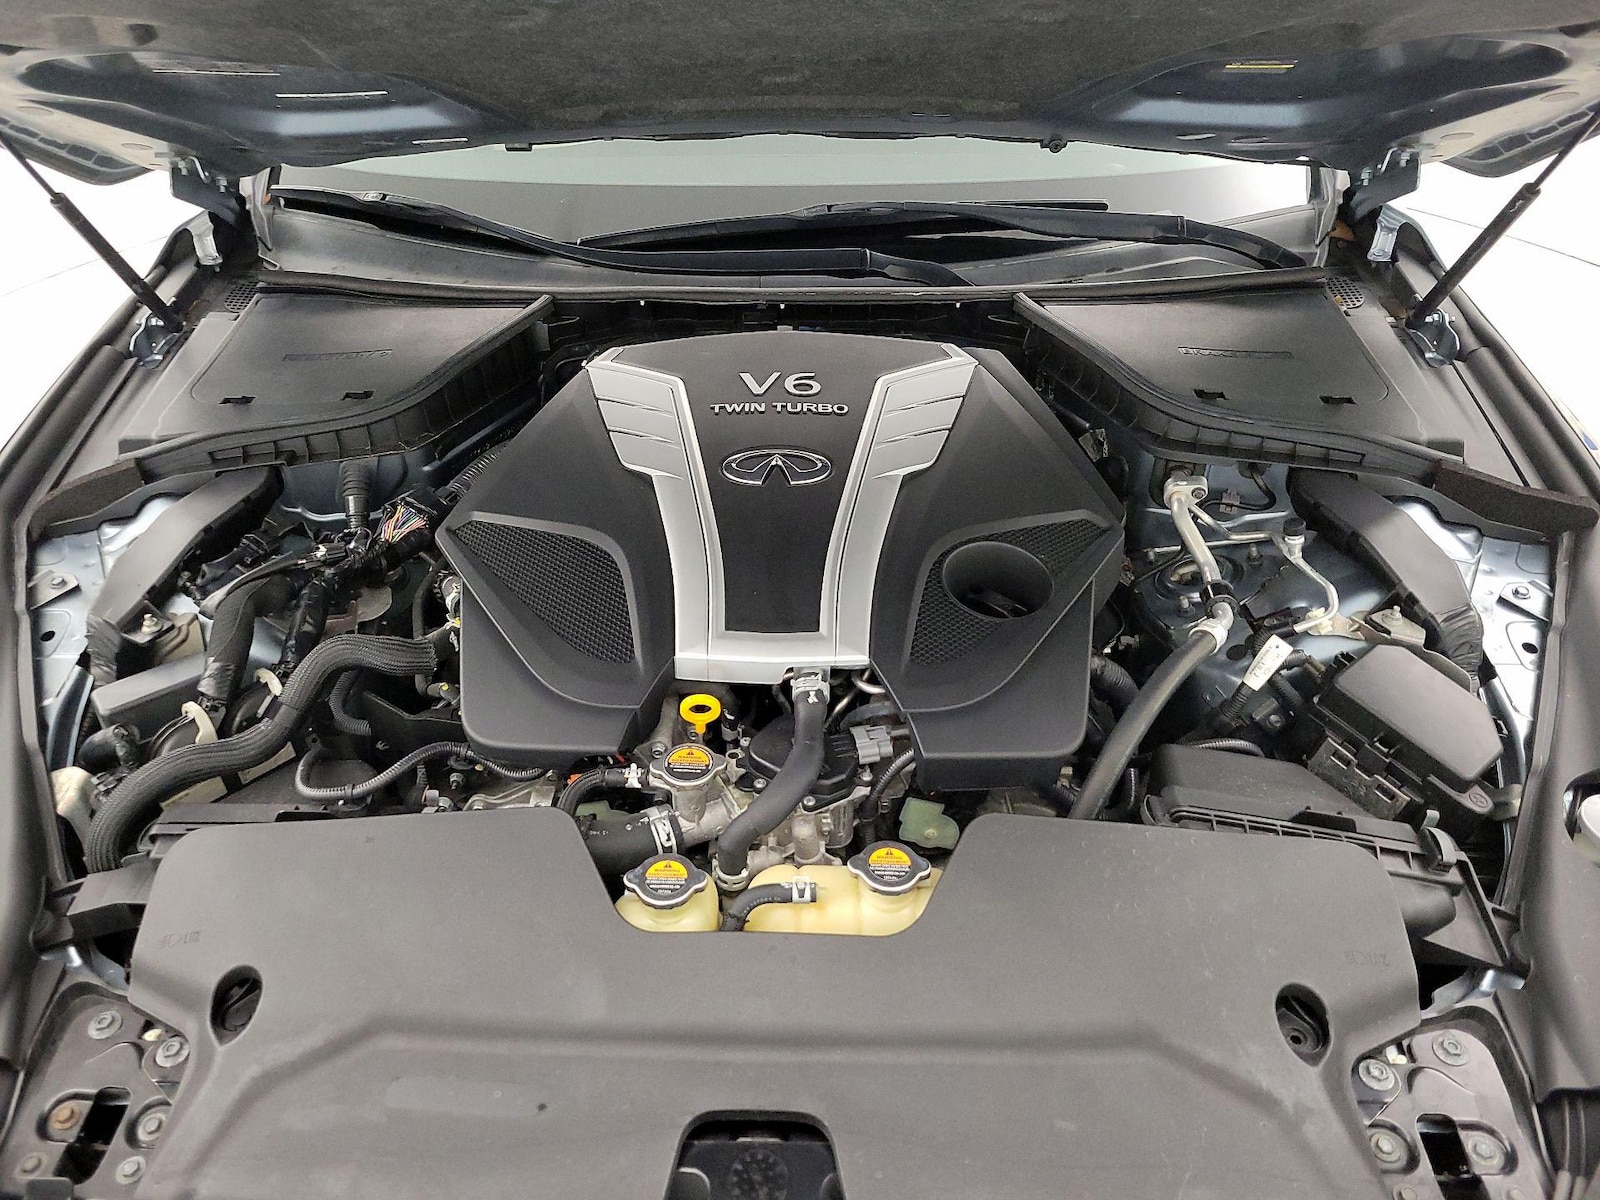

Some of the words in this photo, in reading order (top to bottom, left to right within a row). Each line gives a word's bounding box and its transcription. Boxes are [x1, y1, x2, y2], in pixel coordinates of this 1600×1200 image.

[739, 371, 822, 396] V6
[710, 402, 766, 415] TWIN
[772, 402, 849, 415] TURBO
